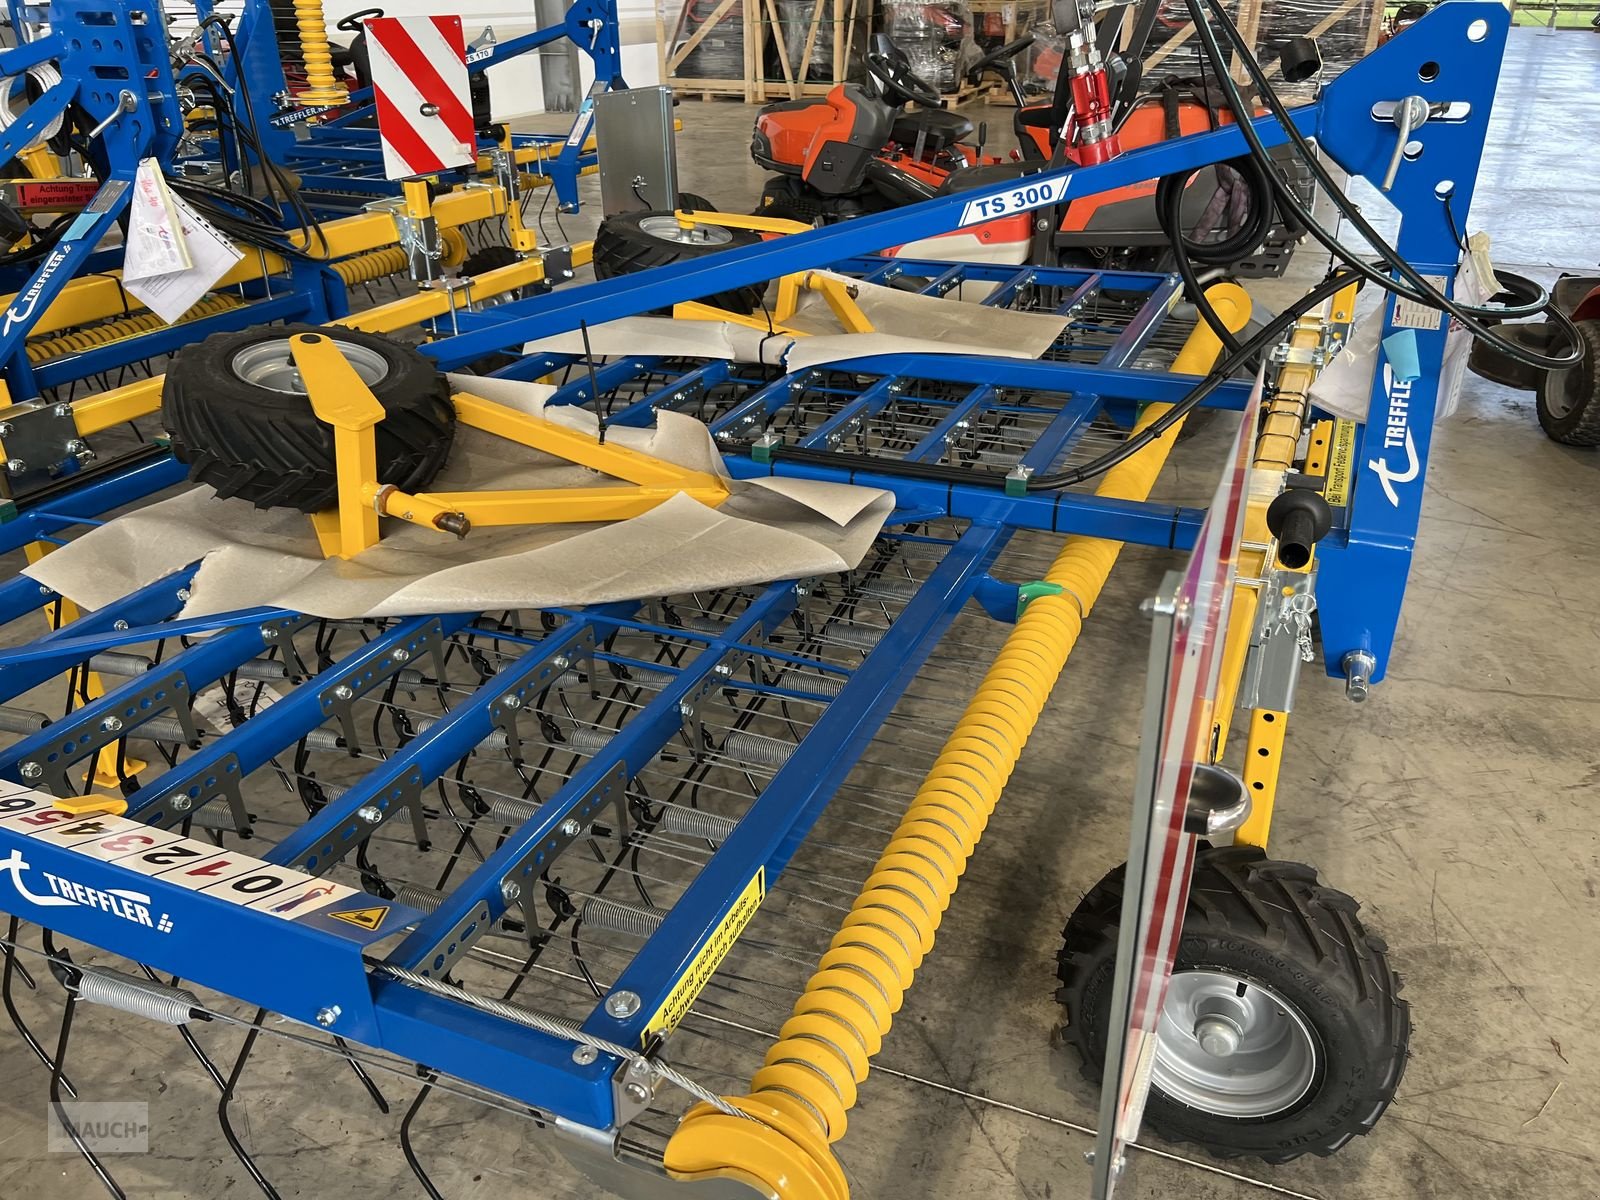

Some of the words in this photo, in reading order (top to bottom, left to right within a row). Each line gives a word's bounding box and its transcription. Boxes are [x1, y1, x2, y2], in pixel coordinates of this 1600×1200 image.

[476, 50, 489, 60] 170
[39, 184, 74, 194] Achtung
[976, 197, 1006, 218] TS
[1012, 184, 1053, 209] 300
[22, 252, 66, 302] TREFFLER
[1384, 376, 1412, 449] TREFFLE
[42, 871, 154, 928] TREFFLER
[662, 972, 695, 1023] Achtung
[695, 945, 714, 974] nicht
[714, 931, 724, 949] im
[723, 896, 750, 936] Arbeits-
[669, 941, 729, 1029] Schwenkbereich
[728, 898, 759, 944] aufhalten
